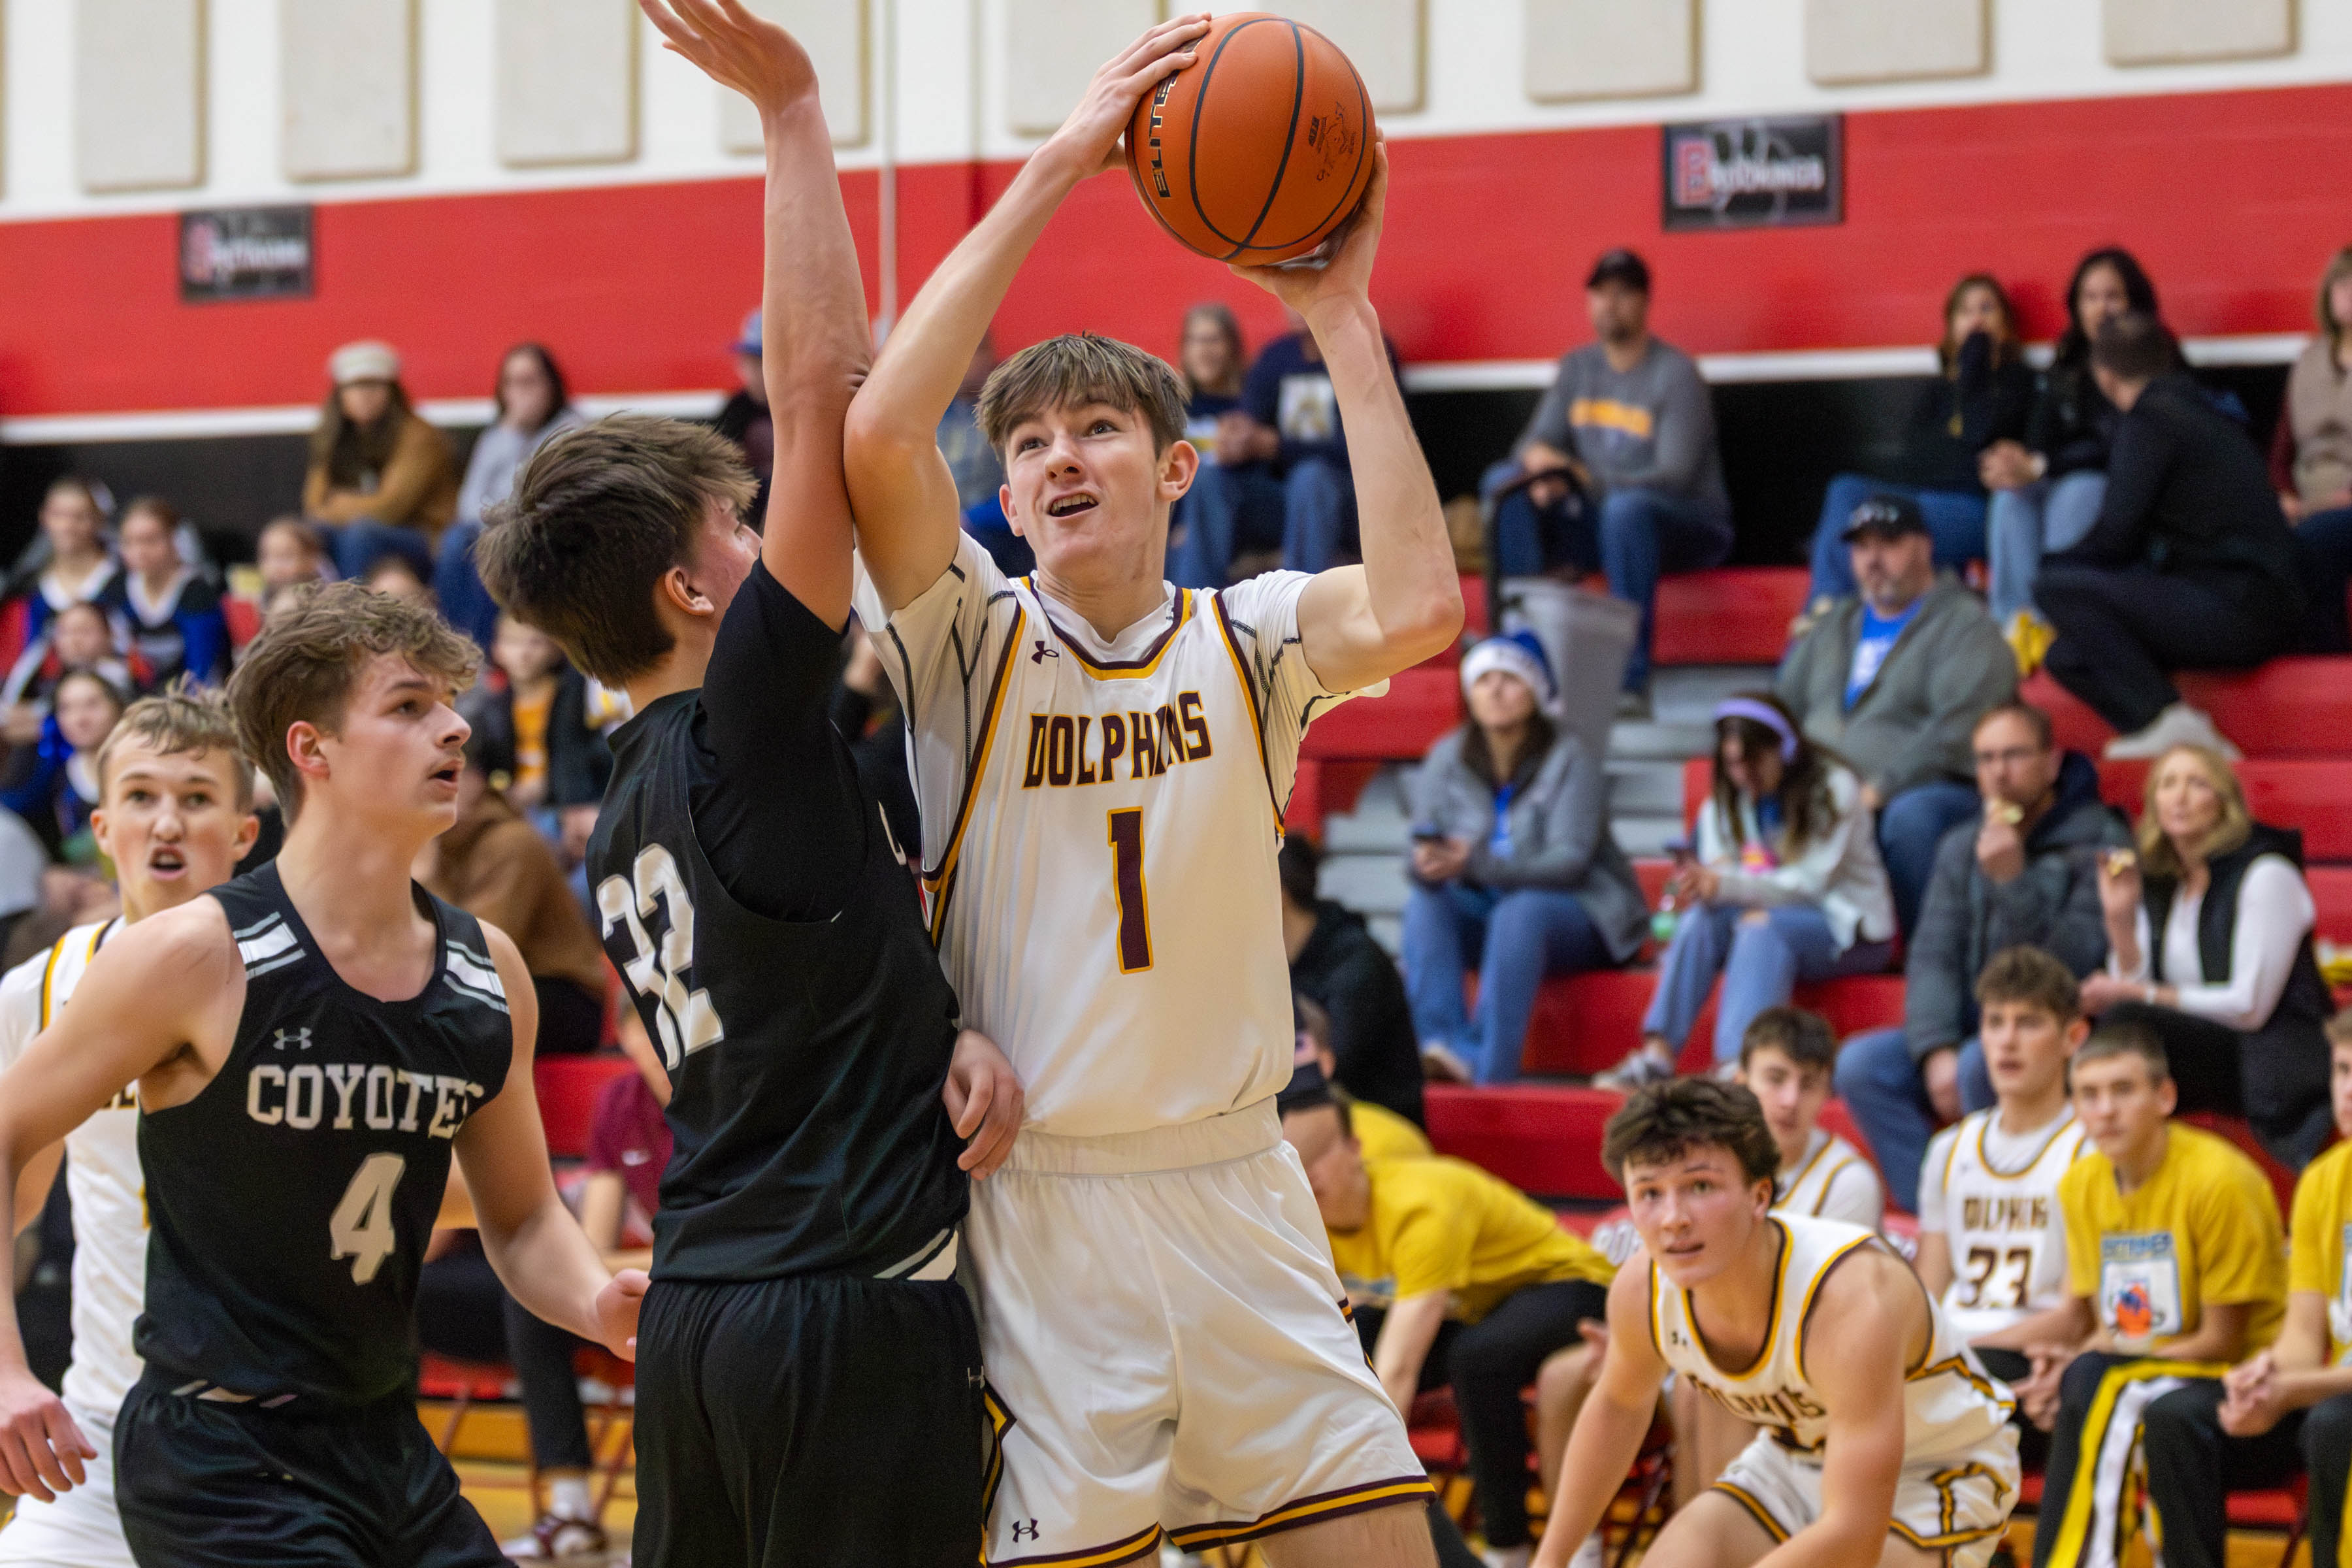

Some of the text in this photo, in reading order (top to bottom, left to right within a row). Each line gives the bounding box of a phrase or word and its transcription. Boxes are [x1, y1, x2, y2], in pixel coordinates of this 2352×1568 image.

[1021, 690, 1213, 789] DOLPHINS
[596, 843, 725, 1071] 32
[1107, 806, 1154, 975] 1
[329, 1152, 406, 1286] 4
[1957, 1245, 2033, 1309] 33
